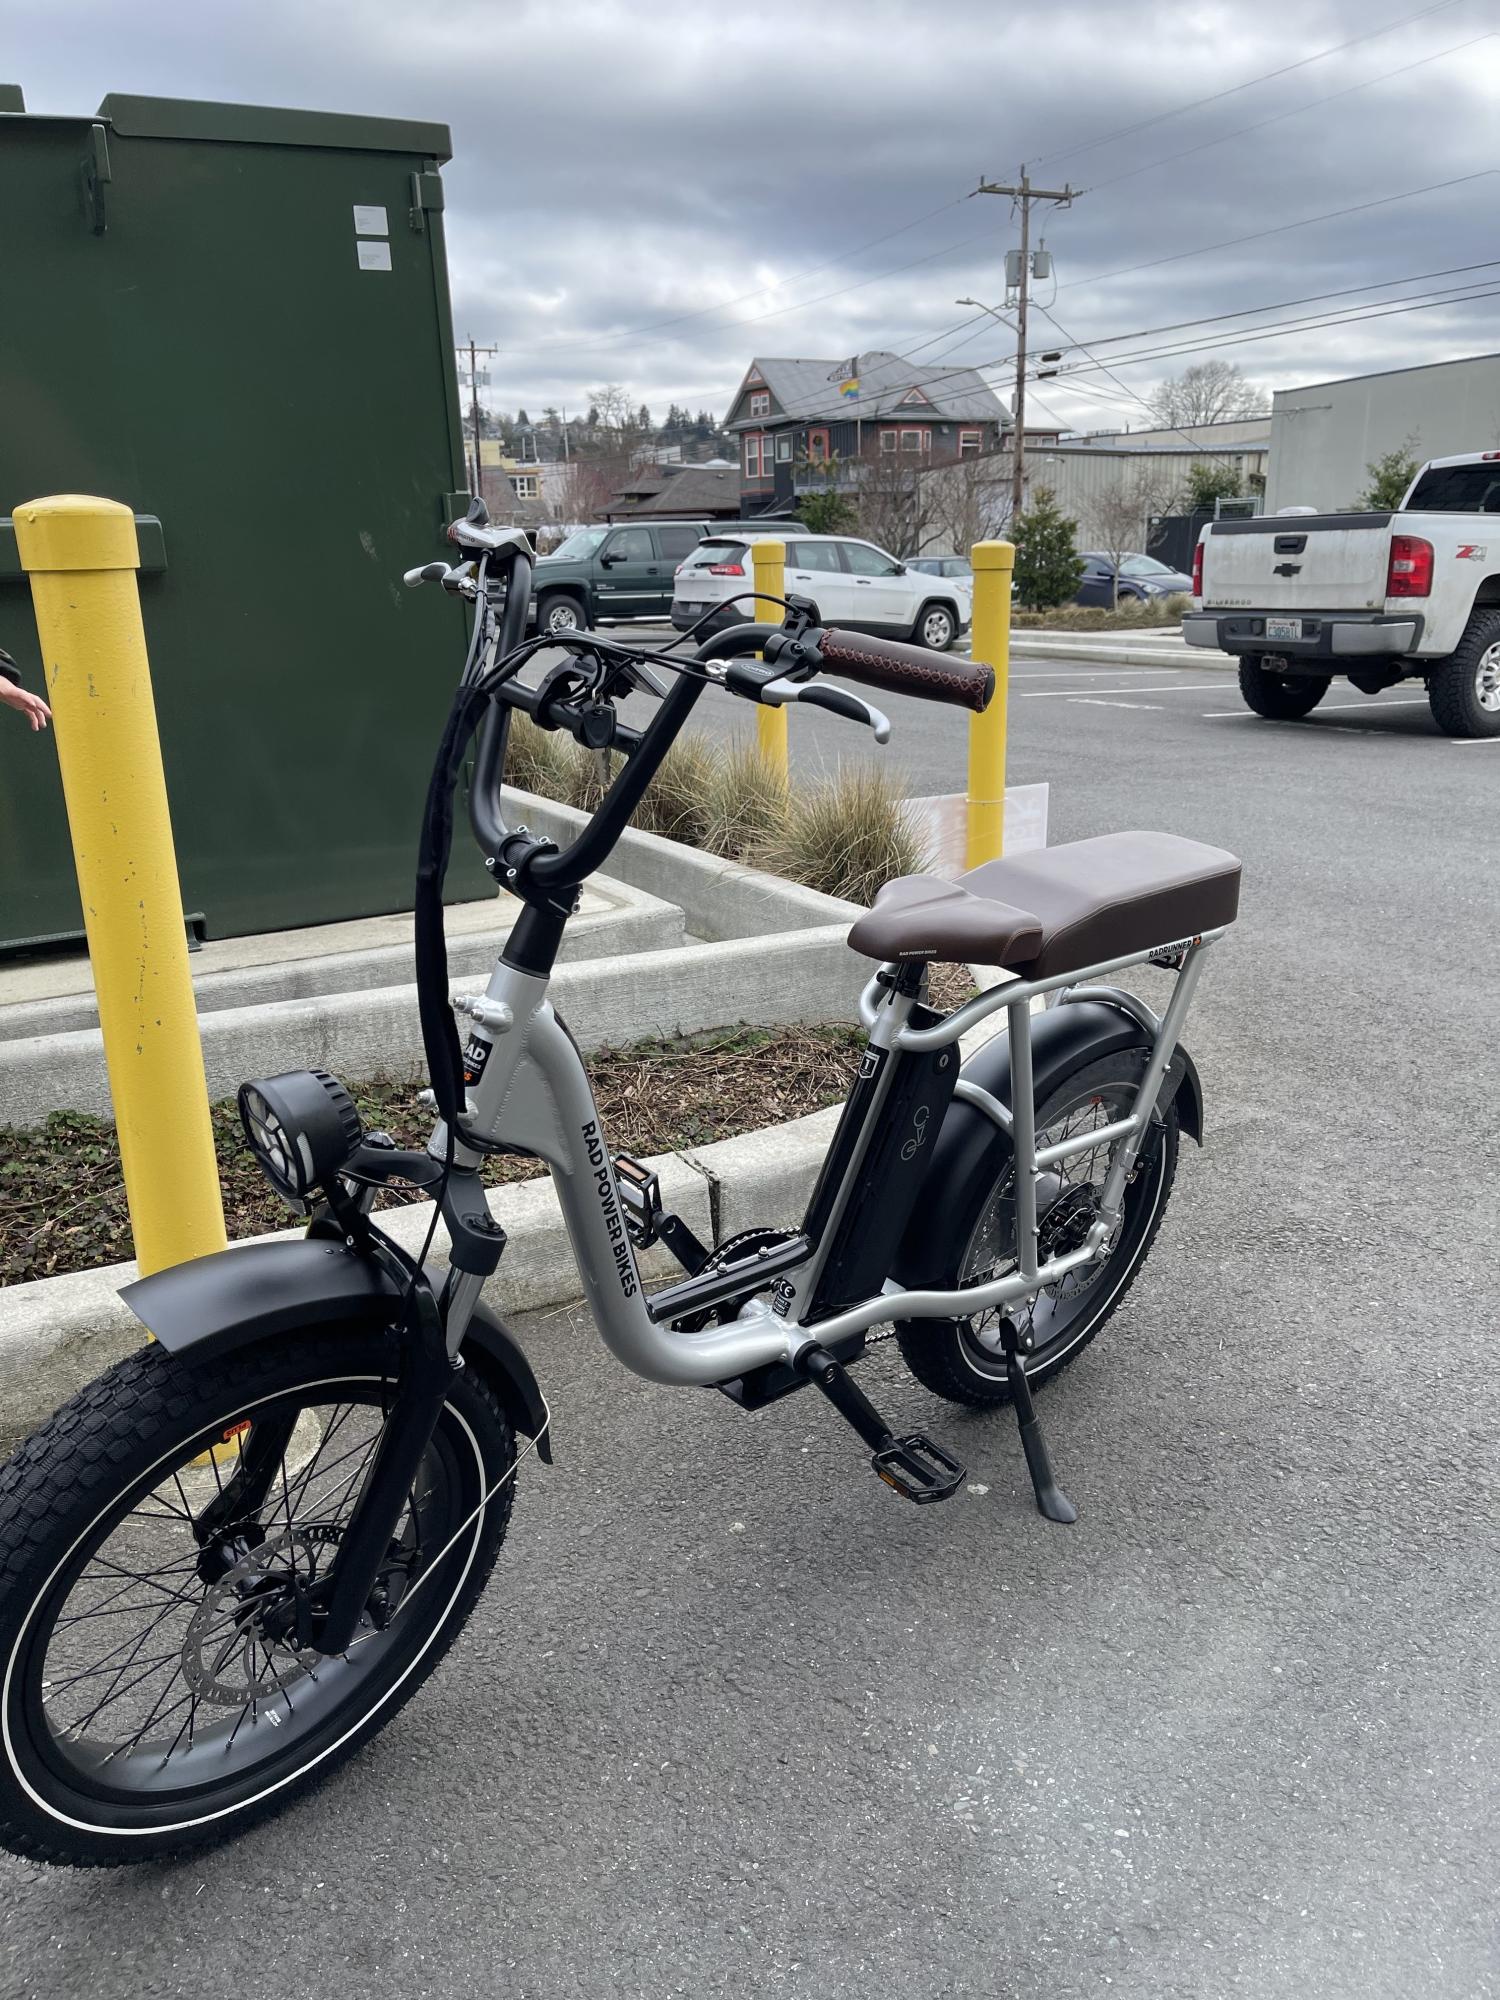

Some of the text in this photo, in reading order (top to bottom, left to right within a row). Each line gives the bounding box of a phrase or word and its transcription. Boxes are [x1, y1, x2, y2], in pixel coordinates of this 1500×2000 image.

[1150, 940, 1191, 958] RADRUNNER
[465, 1043, 486, 1061] AD
[581, 1120, 637, 1298] RAD POWER BIKES
